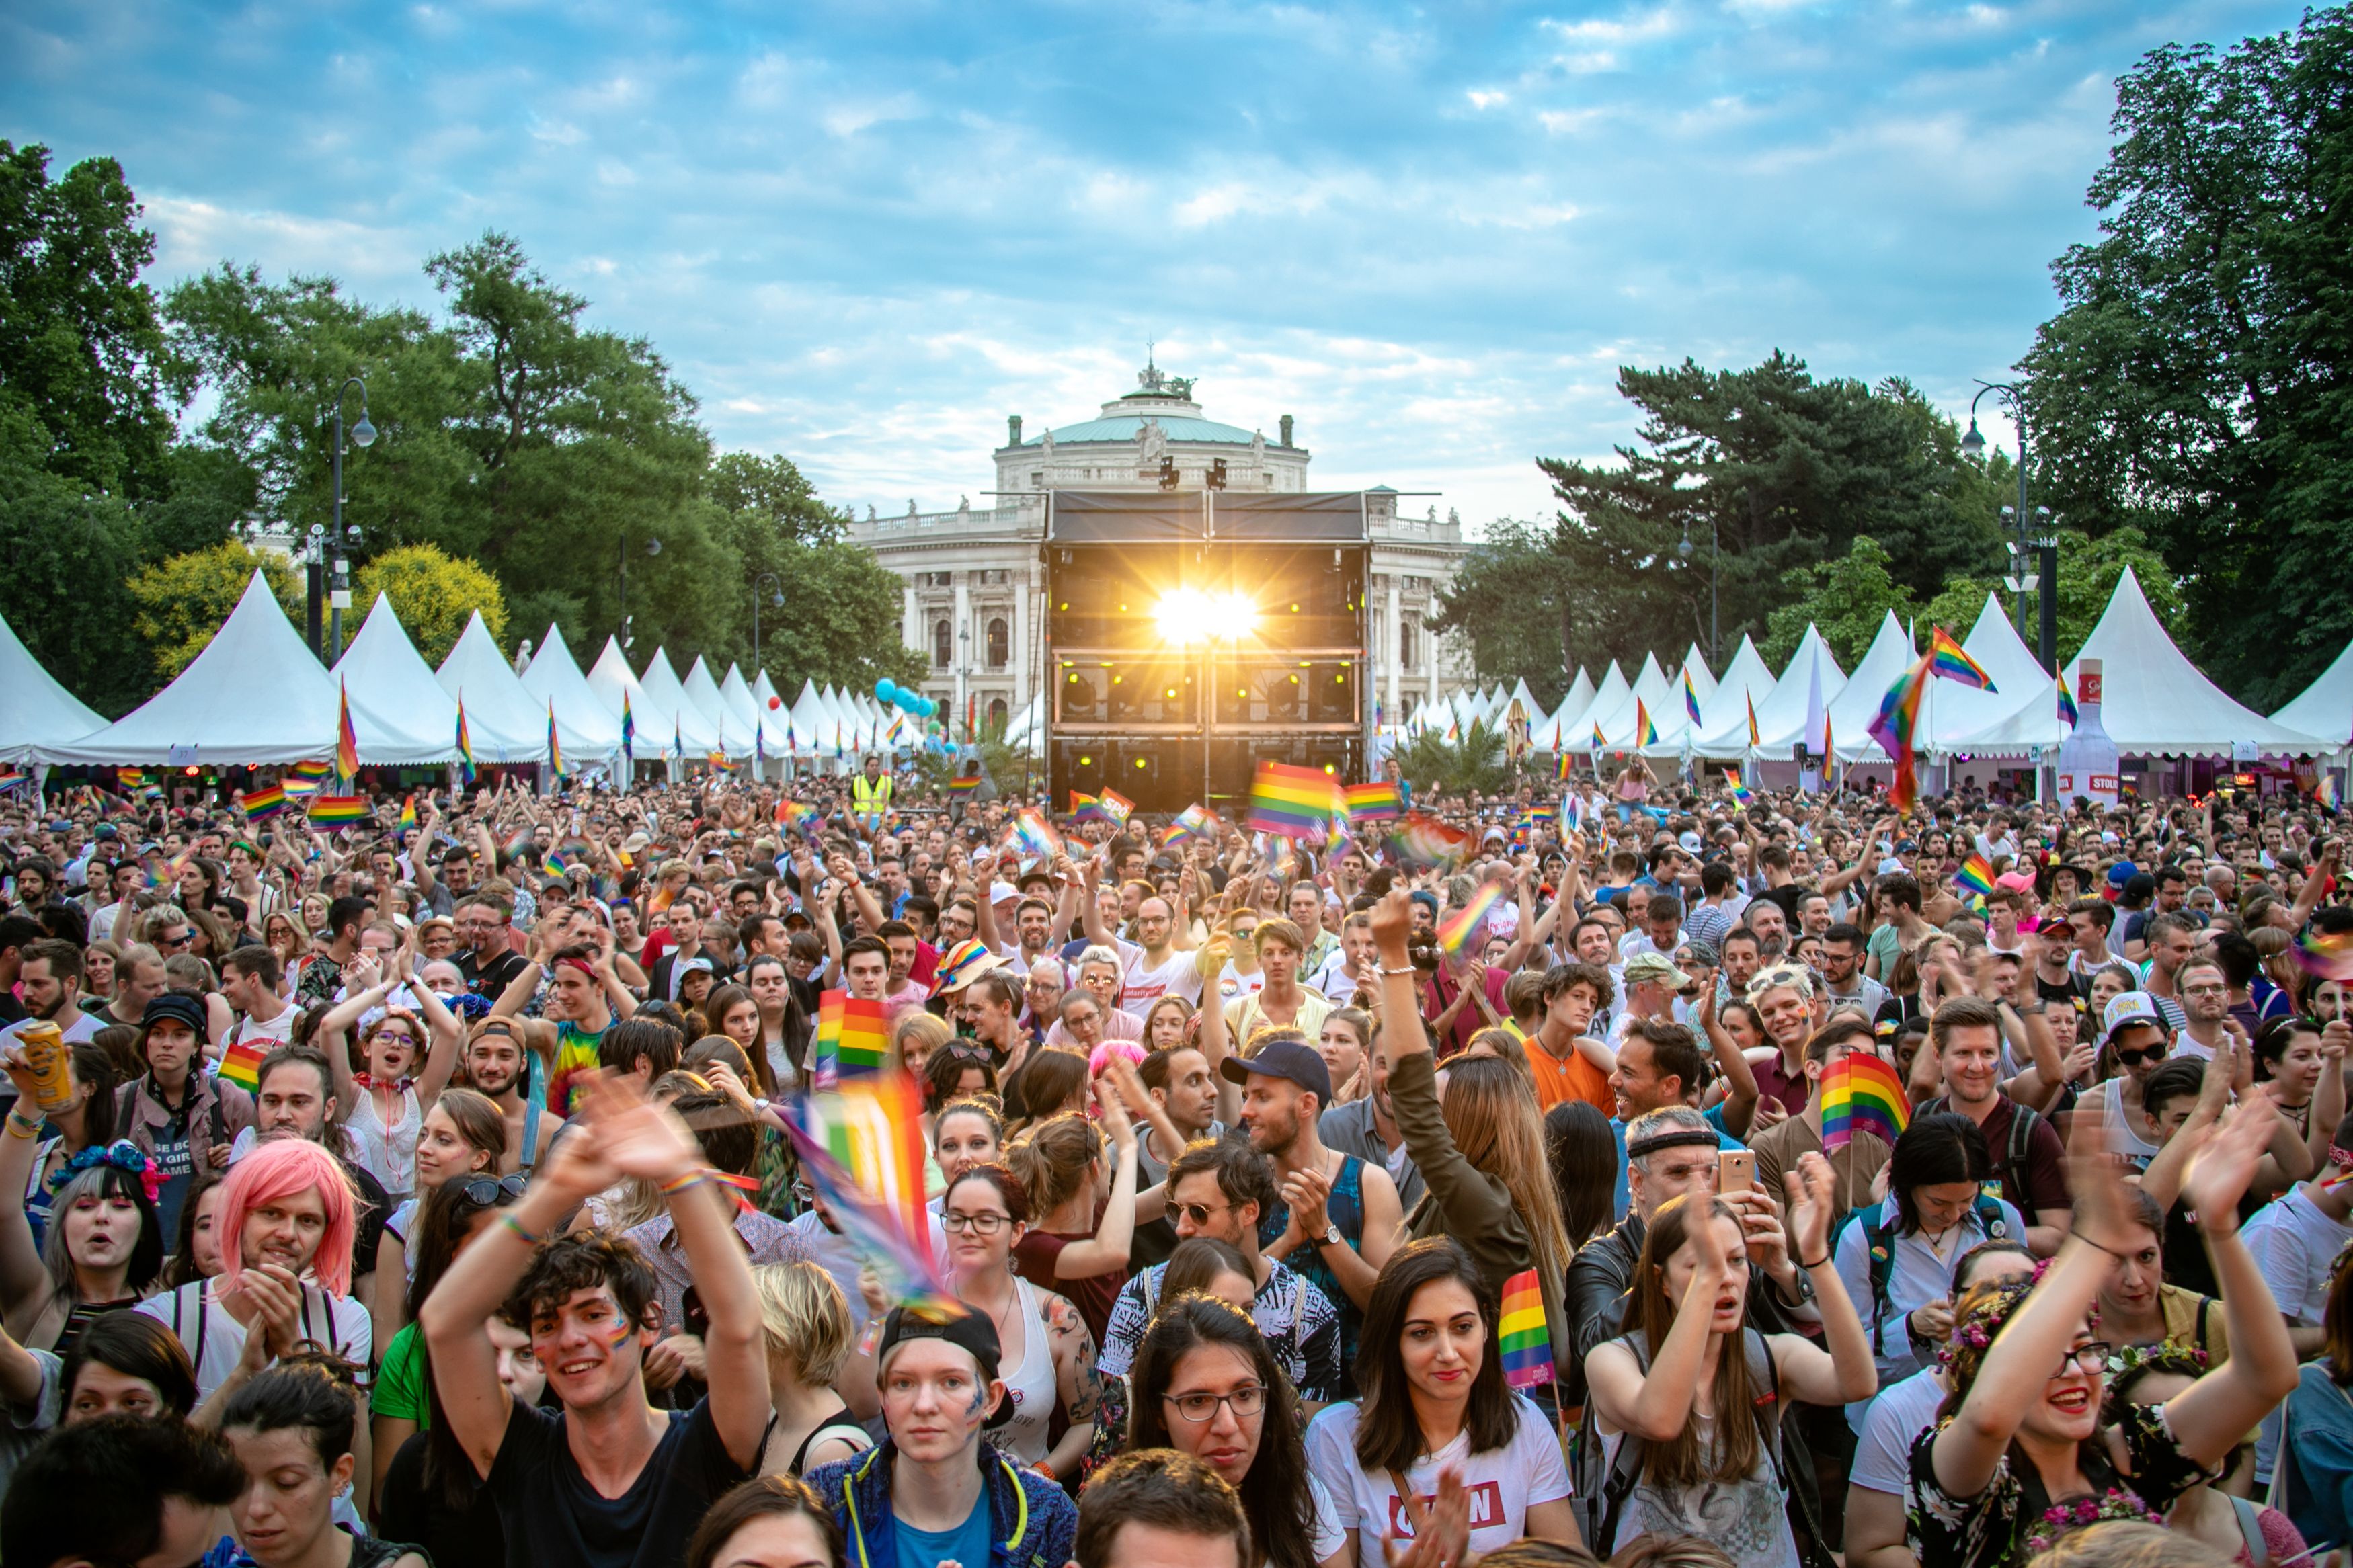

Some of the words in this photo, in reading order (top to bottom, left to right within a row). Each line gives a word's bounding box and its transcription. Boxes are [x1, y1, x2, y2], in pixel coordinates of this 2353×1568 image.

[1102, 798, 1129, 818] SPÖ
[2107, 1007, 2116, 1023] LA
[2115, 998, 2141, 1017] TROYA
[158, 1164, 192, 1176] AME
[1011, 1413, 1035, 1428] ove
